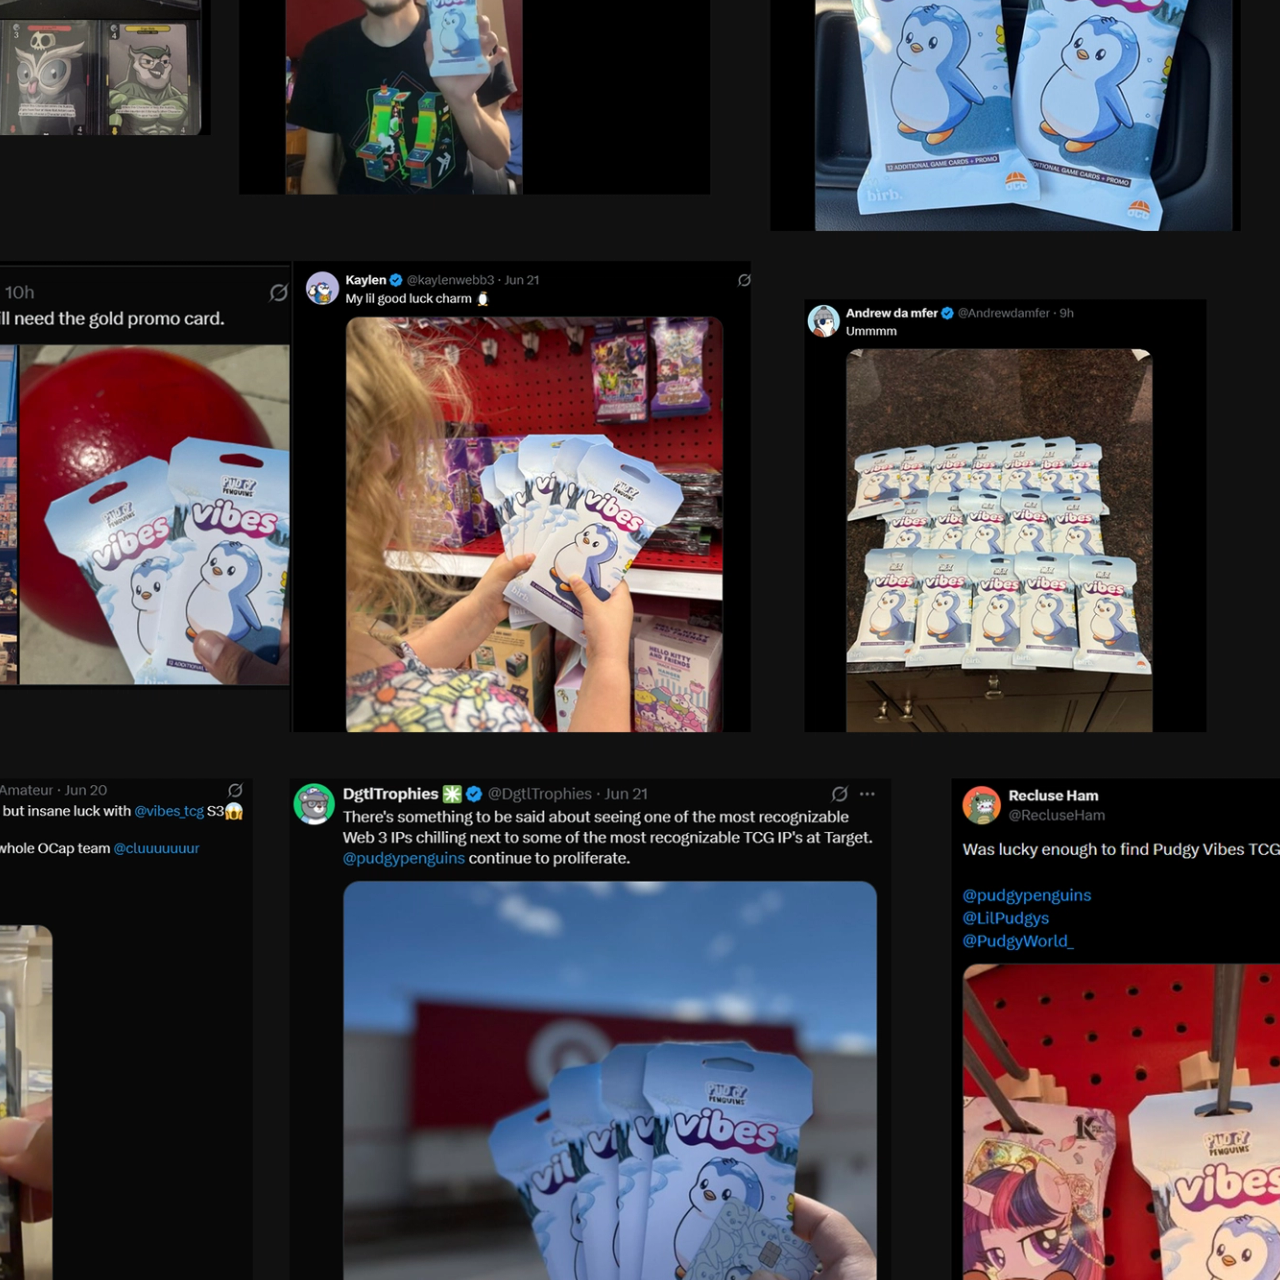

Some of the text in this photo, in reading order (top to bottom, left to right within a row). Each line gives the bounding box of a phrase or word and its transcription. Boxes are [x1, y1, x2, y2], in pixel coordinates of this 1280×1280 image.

[846, 308, 938, 317] Andrew da mfer
[847, 327, 897, 336] Ummmm
[192, 499, 278, 538] vibes
[649, 646, 691, 662] HELLO KITTY
[649, 652, 691, 669] AND FRIENDS
[1009, 809, 1105, 821] @RecluseHam
[673, 1107, 778, 1154] vibes
